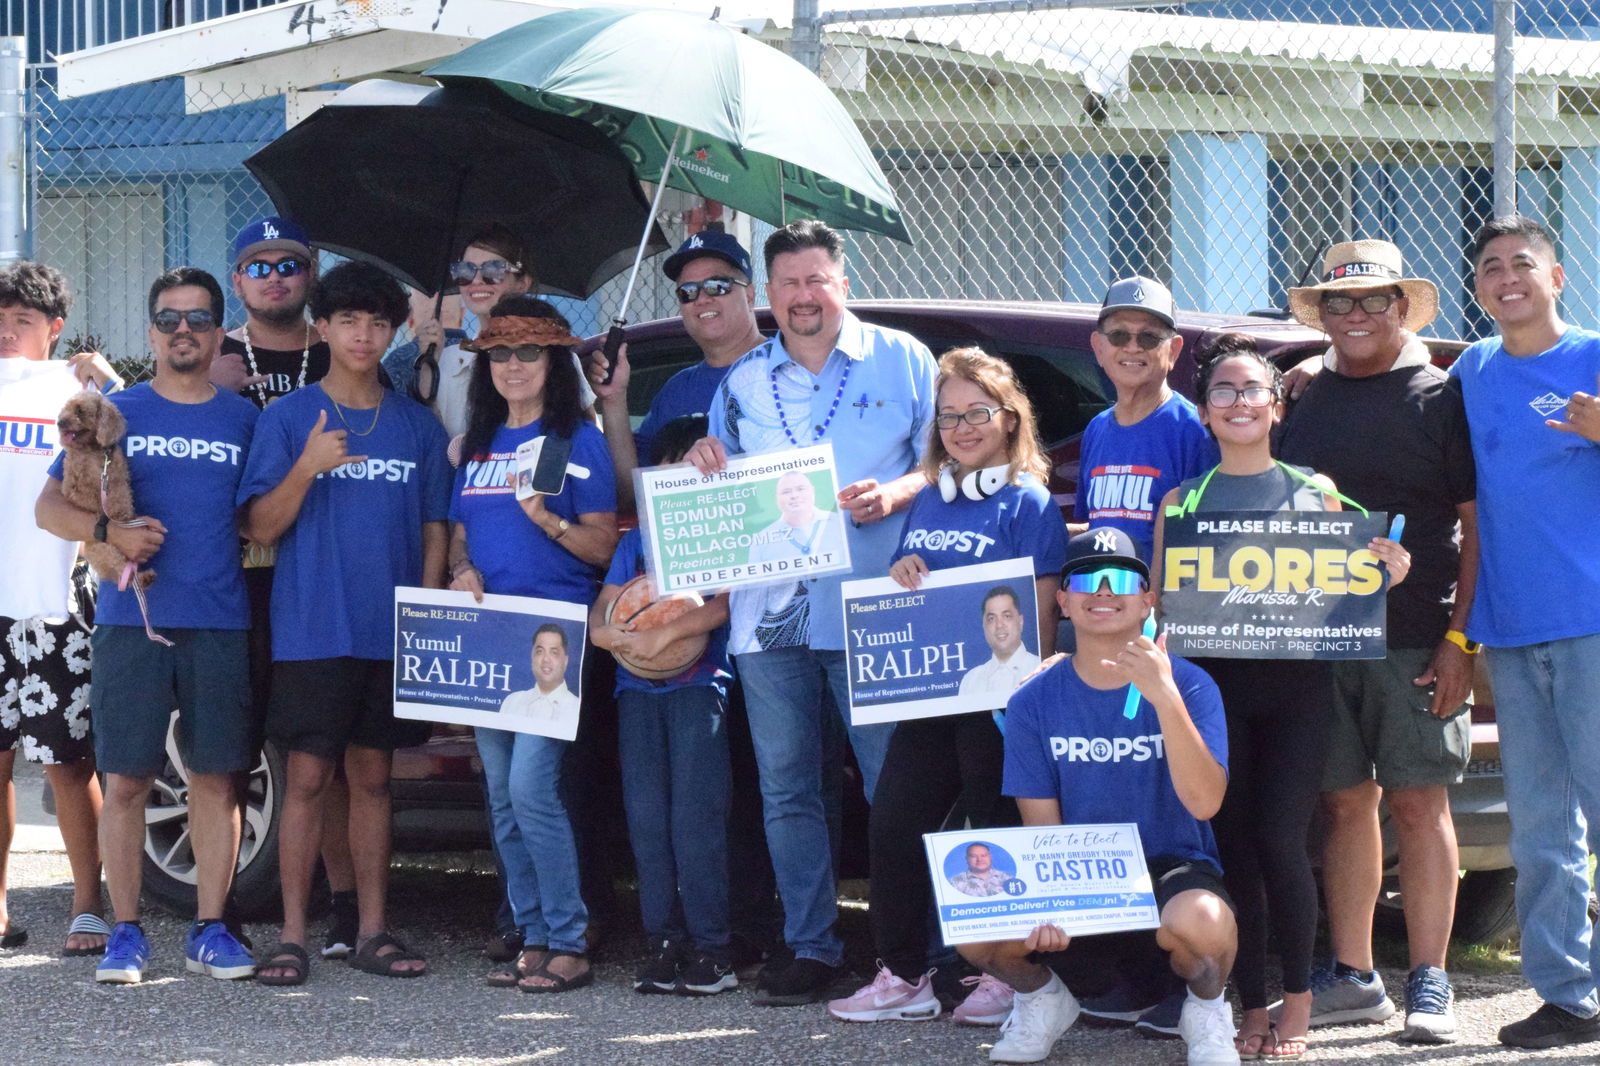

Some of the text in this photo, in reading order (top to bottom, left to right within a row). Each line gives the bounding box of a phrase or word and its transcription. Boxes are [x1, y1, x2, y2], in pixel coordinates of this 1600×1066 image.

[671, 155, 730, 183] Heineken
[263, 221, 279, 240] LA
[126, 435, 242, 466] PROPST
[317, 459, 416, 483] ROPST
[463, 460, 517, 488] YUM
[654, 456, 826, 490] House of Representatives
[660, 485, 758, 510] Please RE-ELECT
[661, 502, 747, 526] EDMUND
[663, 519, 745, 541] SABLAN
[1197, 520, 1354, 535] PLEASE RE-ELECT
[665, 527, 793, 558] VILLAGOMEZ
[669, 553, 736, 571] Precinct 3
[676, 553, 833, 585] INDEPENDENT
[1163, 545, 1384, 596] FLORES
[850, 595, 926, 614] Please RE-ELECT
[1221, 585, 1325, 607] Marissa R.
[402, 607, 479, 622] Please RE-ELECT
[401, 631, 462, 653] Yumul
[852, 622, 914, 648] Yumul
[1163, 622, 1383, 640] House of Representatives
[1184, 639, 1276, 651] INDEPENDENT
[1288, 640, 1351, 651] PRECINCT
[1354, 641, 1362, 650] 3
[401, 654, 513, 692] RALPH
[854, 642, 968, 683] RALPH
[425, 691, 470, 700] Representatives
[474, 695, 497, 704] Precinct
[882, 686, 927, 696] Representatives
[931, 682, 954, 691] Precinct
[1049, 734, 1164, 763] PROPST
[1033, 831, 1122, 850] Vote to Elect
[1040, 852, 1065, 860] MANNY
[1067, 851, 1100, 859] GREGORY
[1102, 849, 1134, 857] TENORIO
[1035, 858, 1128, 883] CASTRO
[1009, 881, 1022, 894] #1
[950, 902, 1008, 917] Democrats
[1010, 900, 1050, 912] Deliver!
[1052, 899, 1076, 907] Vote
